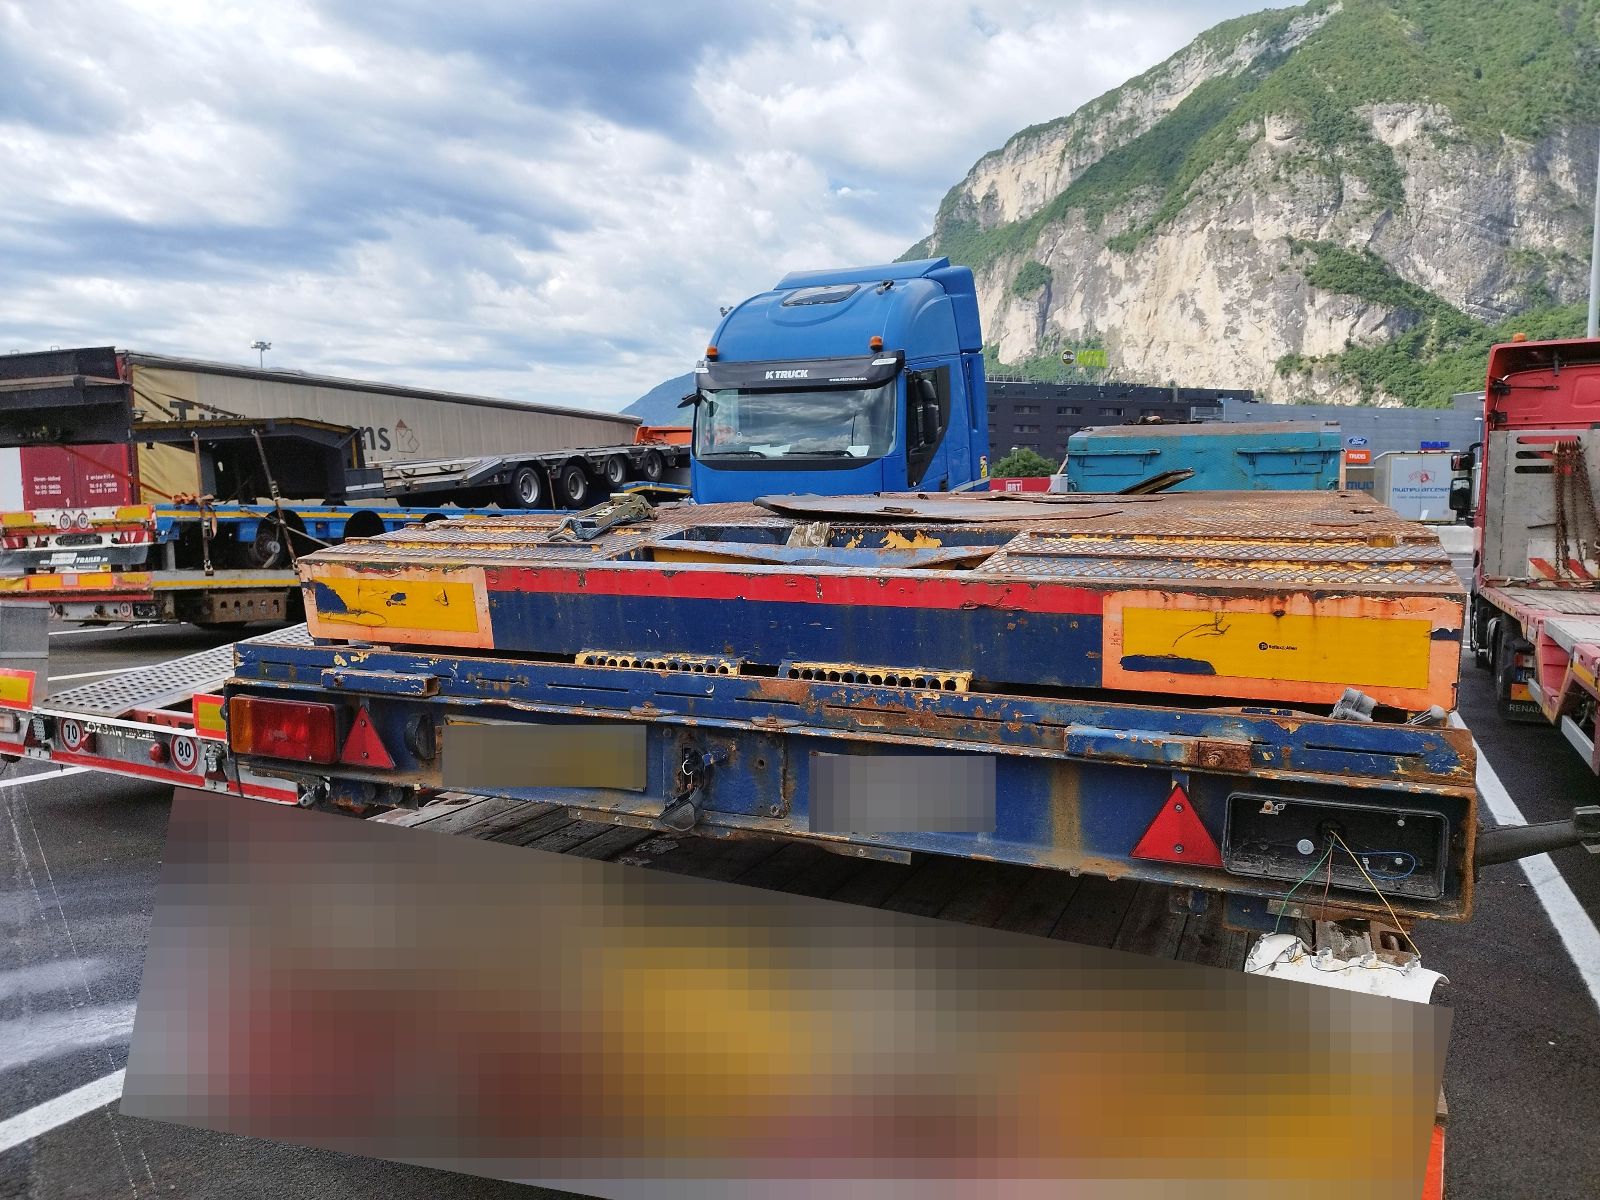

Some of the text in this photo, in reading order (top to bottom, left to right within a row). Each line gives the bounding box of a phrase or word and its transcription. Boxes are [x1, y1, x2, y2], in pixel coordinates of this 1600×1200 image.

[775, 369, 809, 379] TRUCK
[1007, 483, 1021, 492] BRT
[1508, 703, 1543, 714] RENAU
[65, 724, 78, 740] 70
[178, 740, 191, 758] 80
